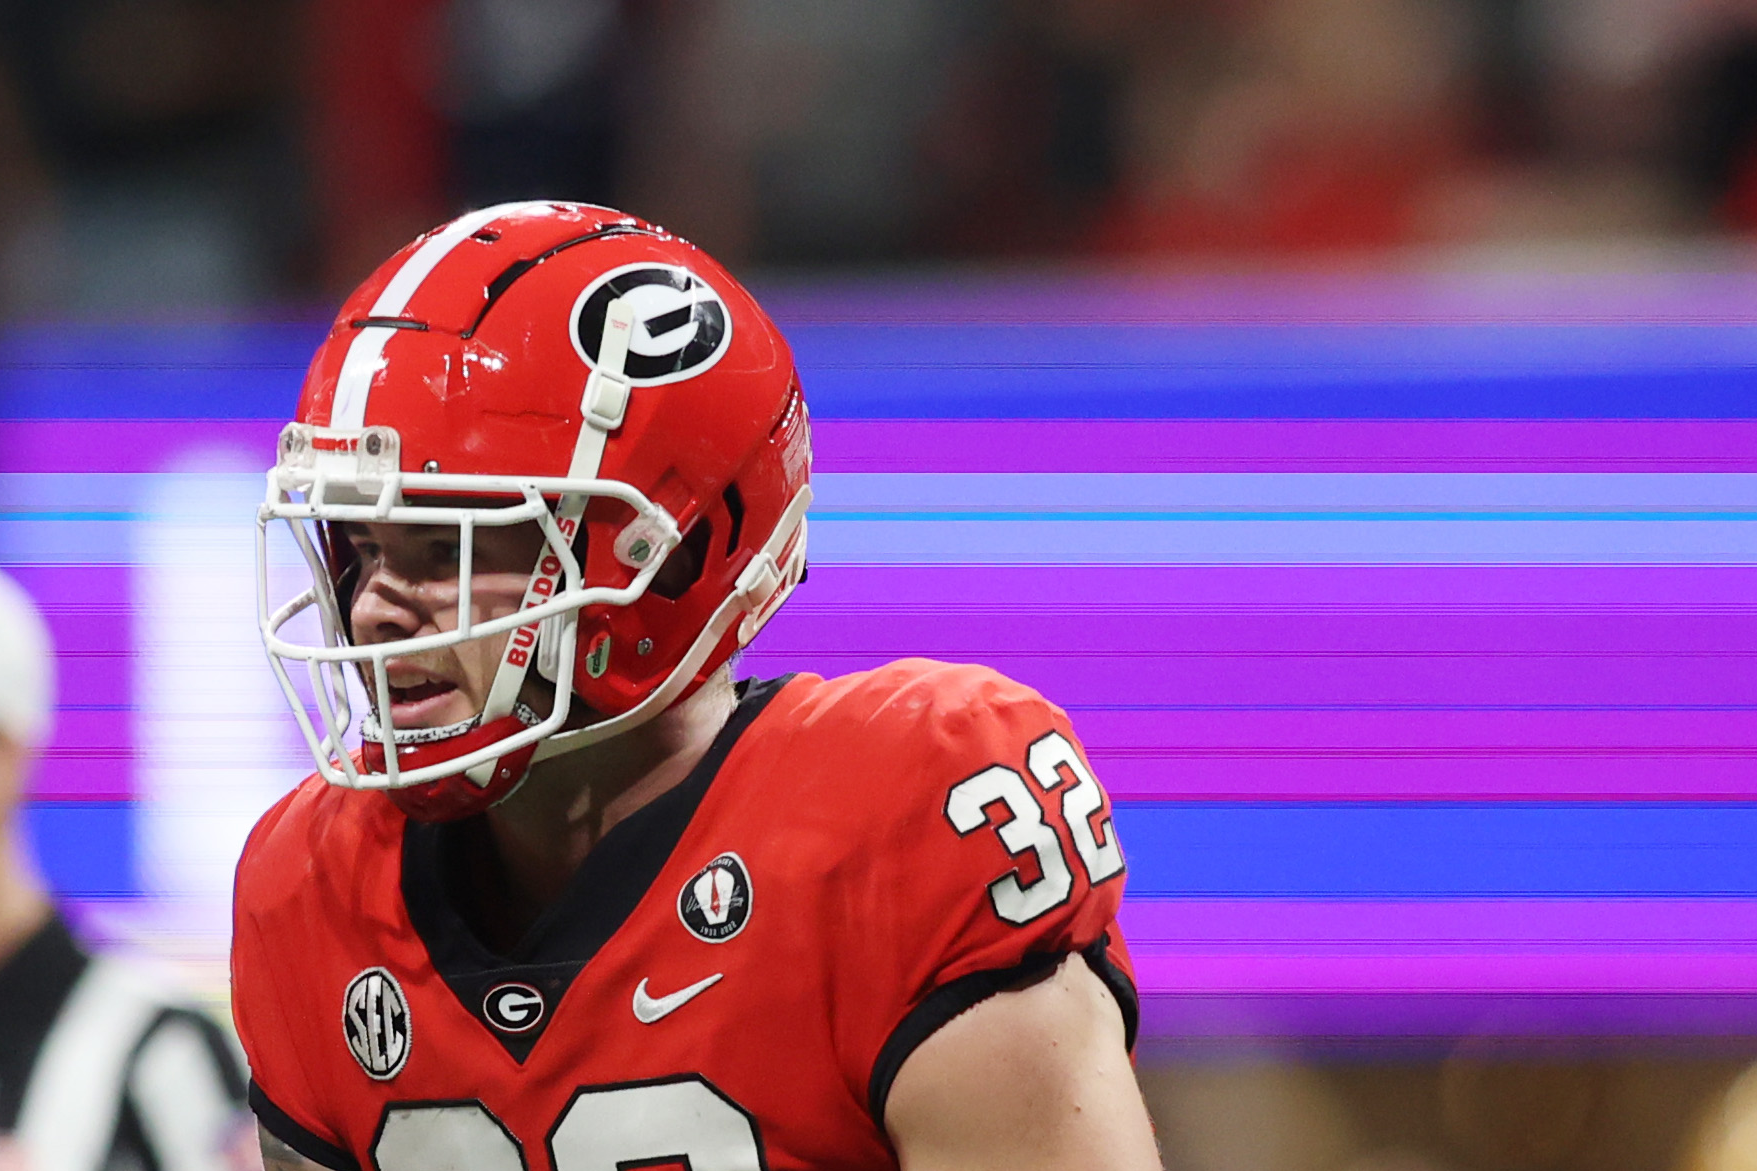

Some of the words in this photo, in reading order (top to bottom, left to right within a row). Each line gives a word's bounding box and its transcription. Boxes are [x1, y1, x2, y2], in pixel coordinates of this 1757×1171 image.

[570, 263, 732, 386] G
[944, 729, 1126, 928] 32
[347, 974, 407, 1072] SEC
[483, 983, 544, 1033] G
